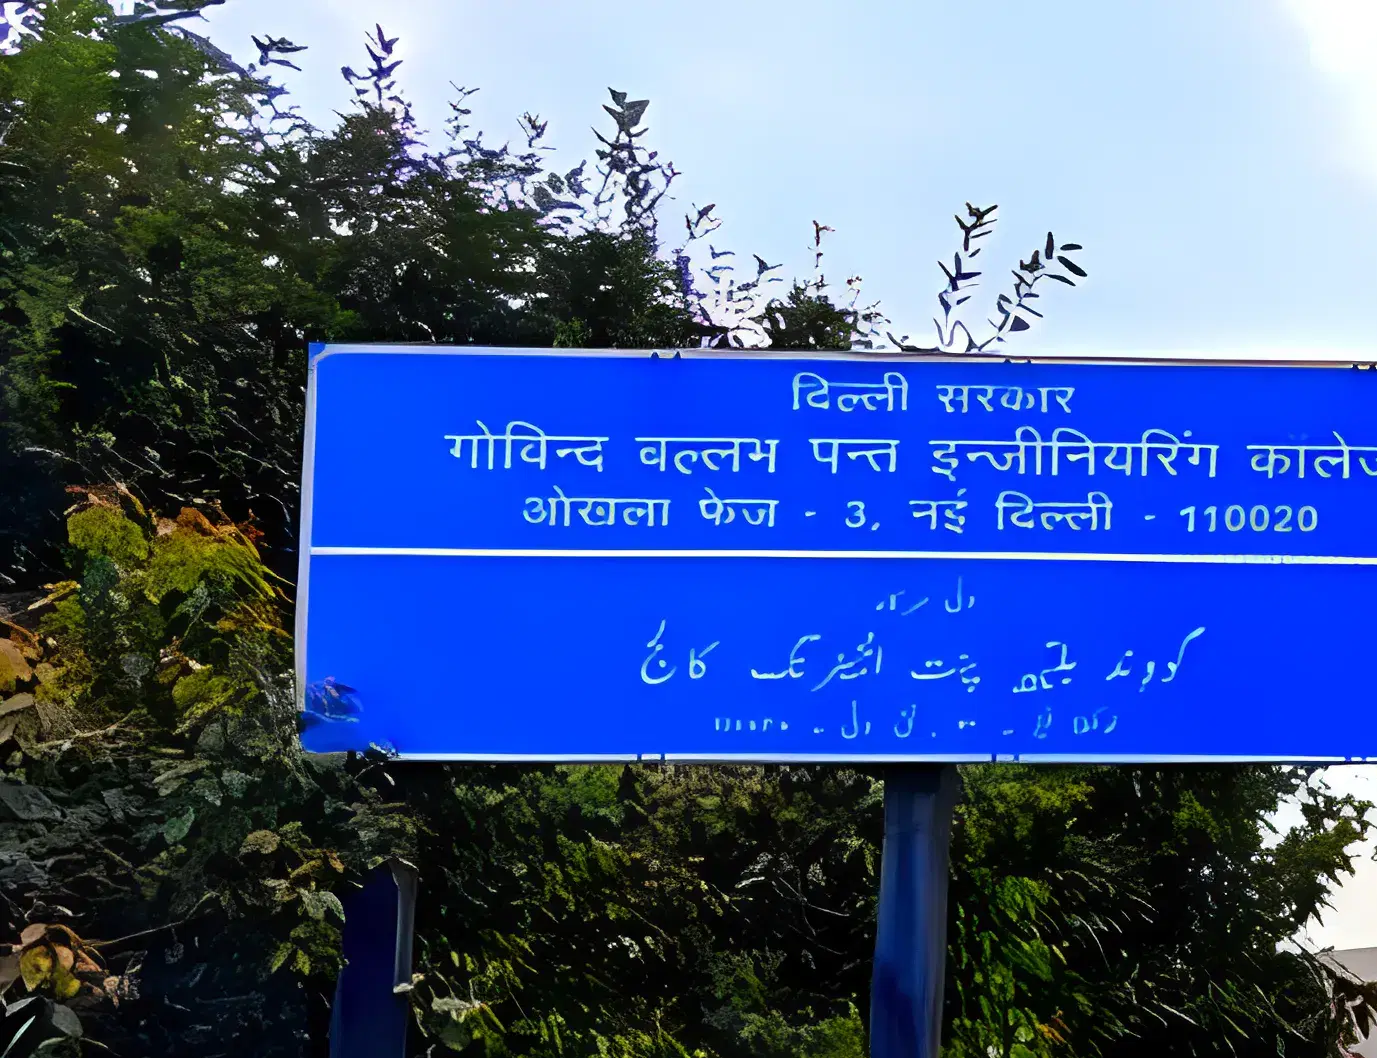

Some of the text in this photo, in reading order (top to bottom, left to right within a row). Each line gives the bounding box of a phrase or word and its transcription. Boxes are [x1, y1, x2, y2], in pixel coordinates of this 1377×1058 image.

[443, 419, 610, 472] गोविन्द
[634, 436, 780, 474] वल्लभ
[807, 438, 901, 475] पन्त
[928, 425, 1220, 482] इन्जीनियरिंग
[522, 487, 672, 527] ओखला
[1179, 504, 1318, 533] 110020
